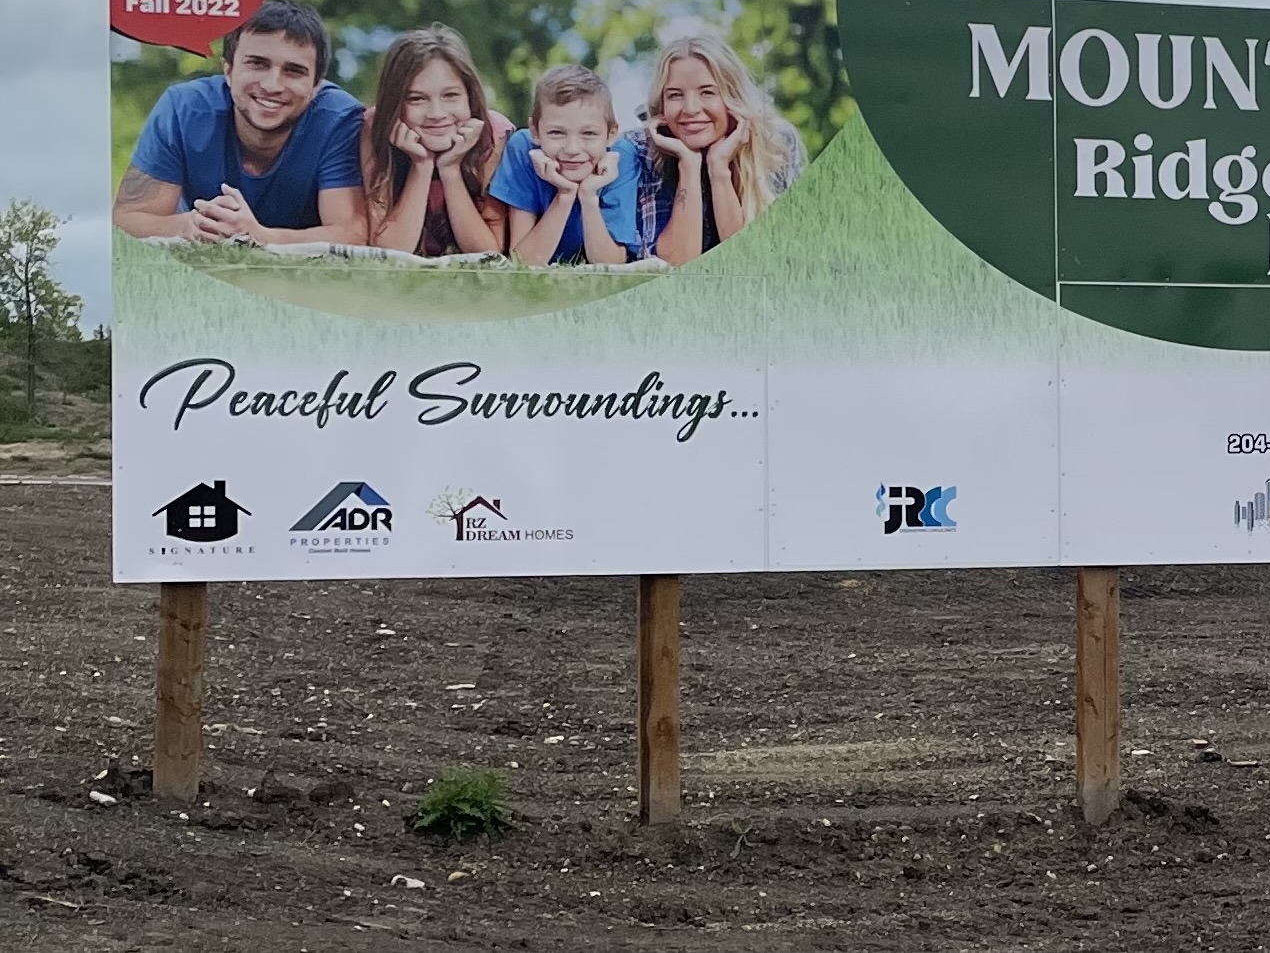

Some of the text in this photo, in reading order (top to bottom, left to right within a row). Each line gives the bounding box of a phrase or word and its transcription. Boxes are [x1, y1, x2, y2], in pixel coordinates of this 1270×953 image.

[139, 357, 761, 444] Peaceful Surroundings...
[884, 486, 957, 535] JRCC
[317, 507, 393, 533] ADR
[466, 517, 487, 529] RZ
[466, 529, 574, 541] DREAM HOMES
[289, 537, 390, 547] PROPERTIES
[149, 546, 256, 555] SIGNATURE
